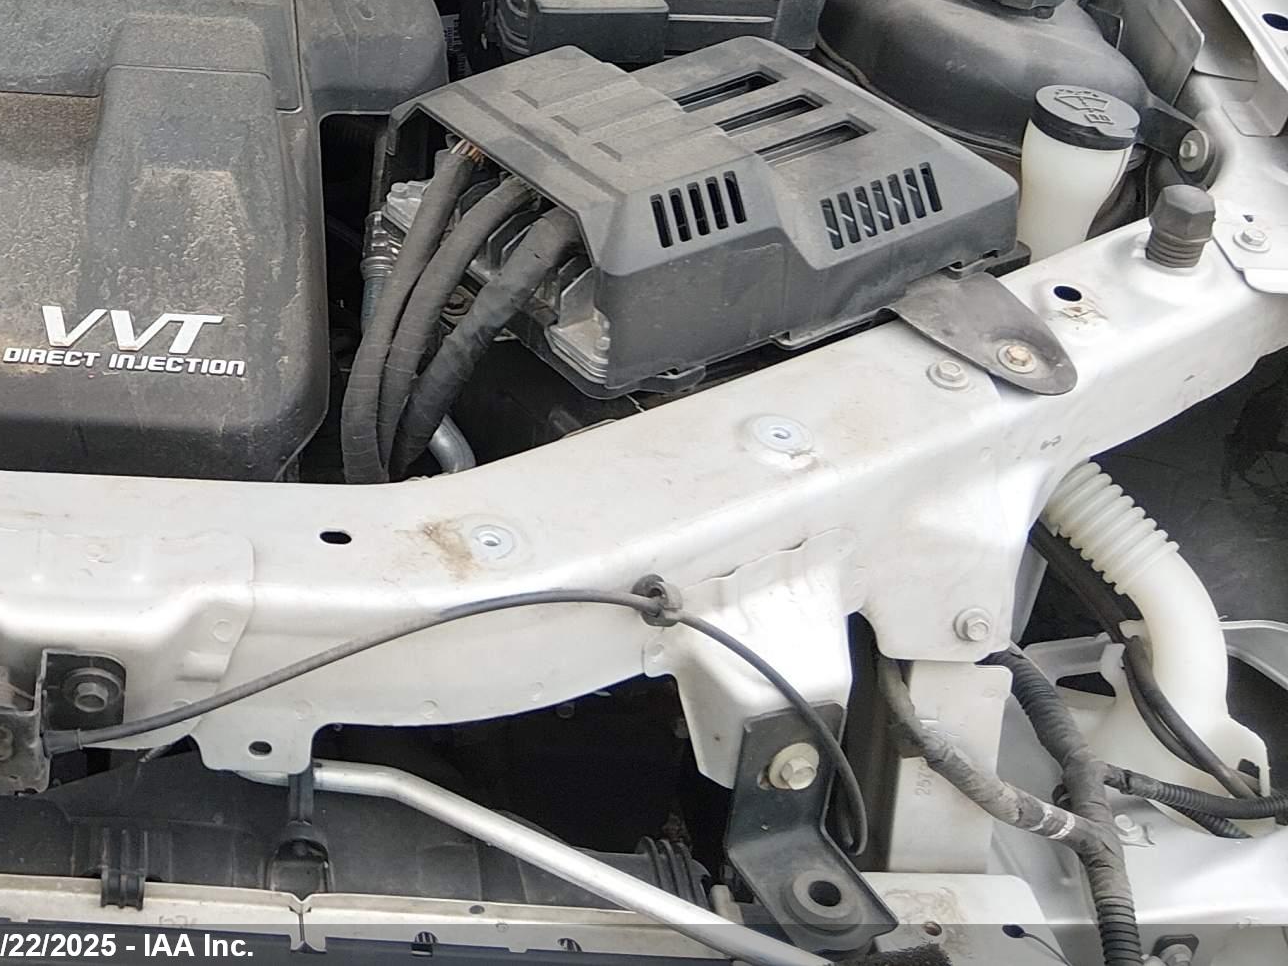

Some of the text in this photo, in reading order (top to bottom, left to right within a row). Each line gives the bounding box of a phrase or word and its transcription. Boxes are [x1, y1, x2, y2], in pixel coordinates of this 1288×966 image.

[41, 305, 224, 354] VVT
[2, 347, 247, 377] DIRECT INJECTION
